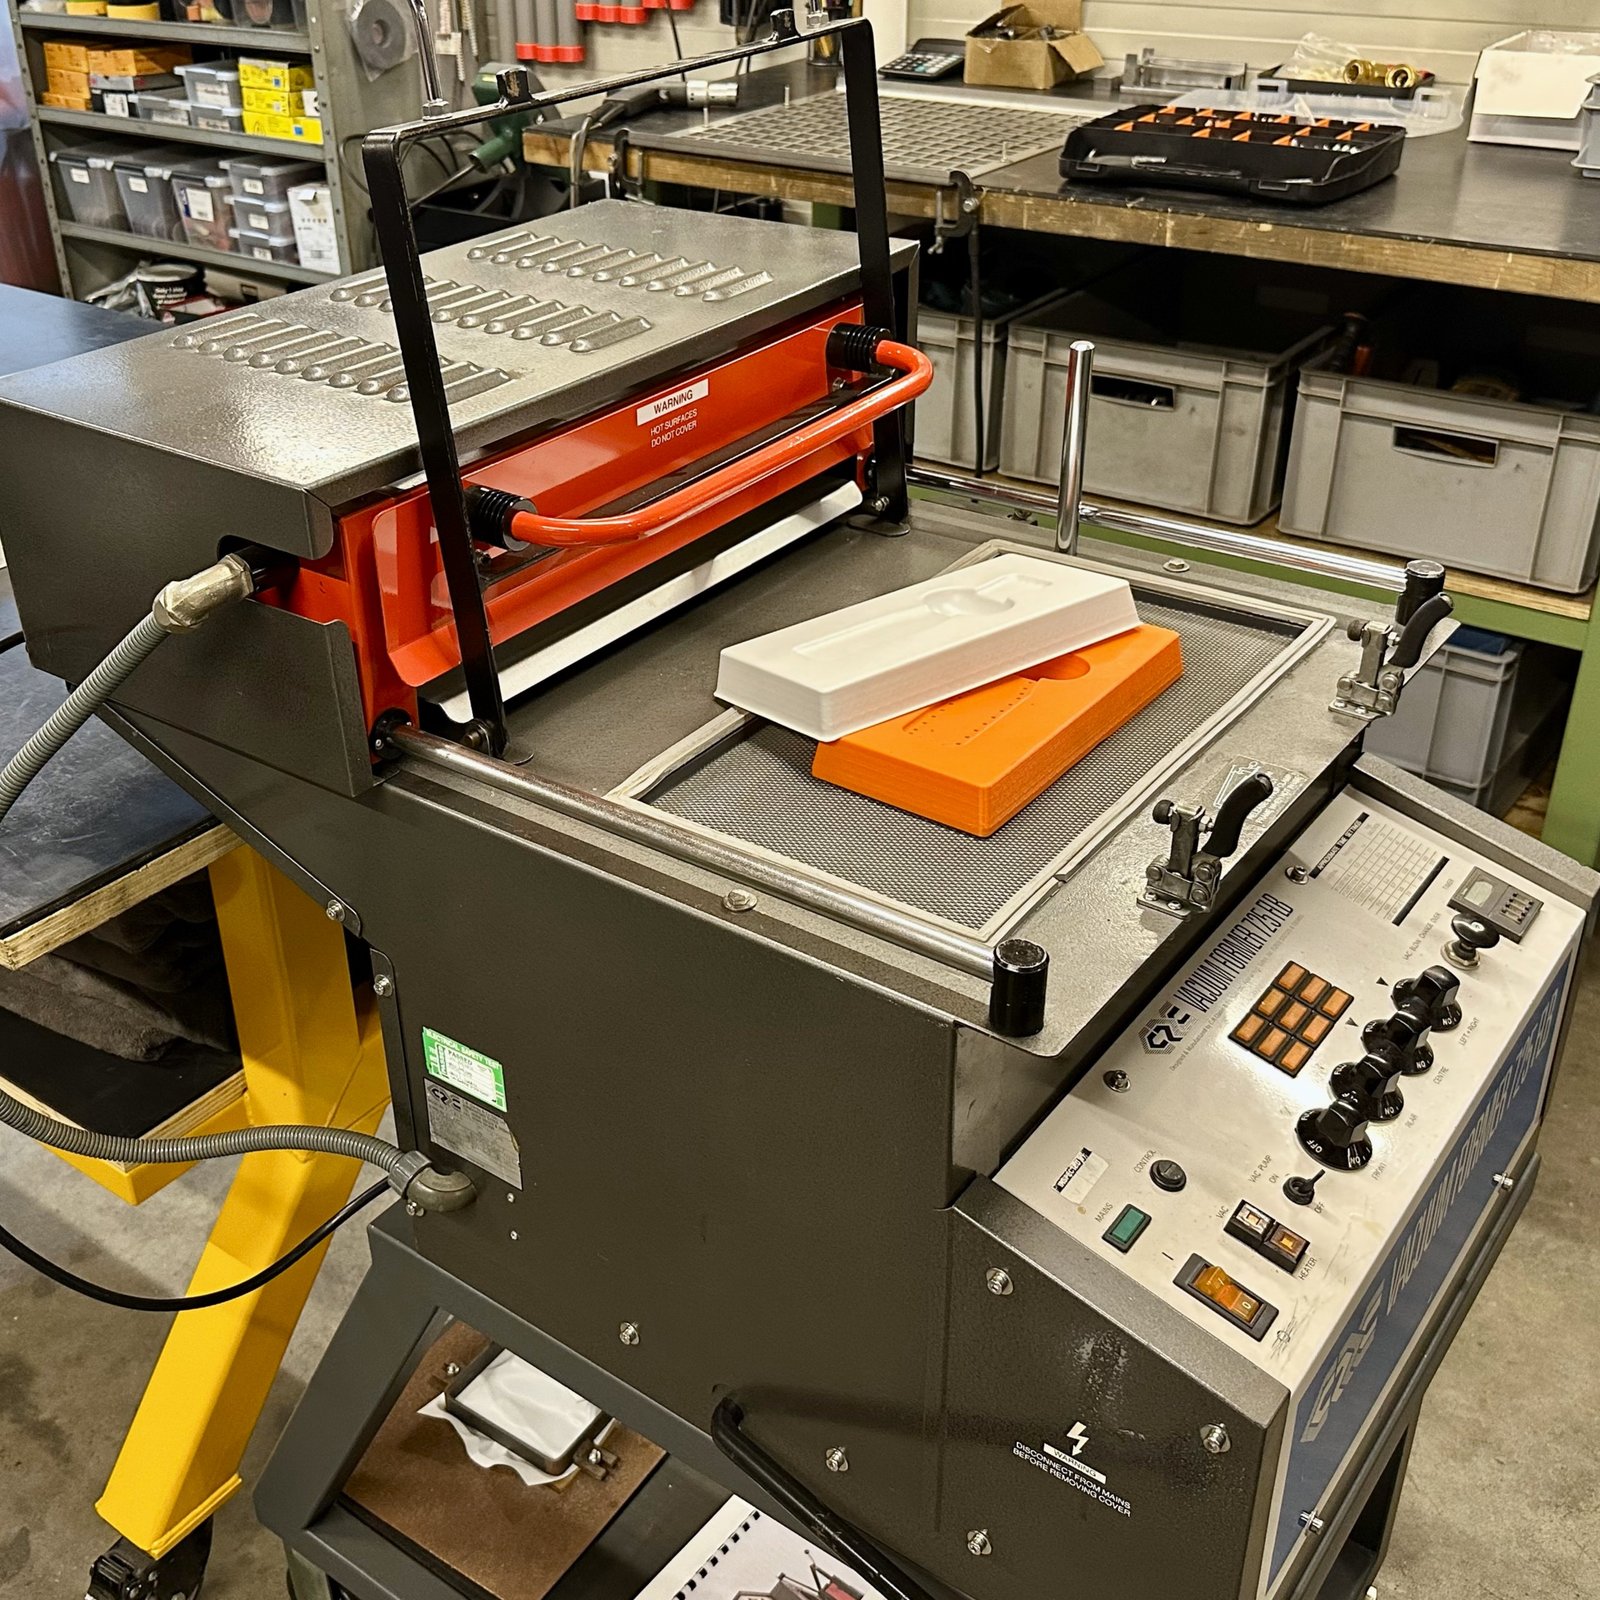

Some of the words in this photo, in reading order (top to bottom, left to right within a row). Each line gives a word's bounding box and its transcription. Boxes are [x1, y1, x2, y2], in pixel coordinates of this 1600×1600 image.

[653, 389, 693, 414] WARNING
[650, 423, 665, 436] HOT
[665, 408, 698, 430] SURFACES
[651, 437, 661, 448] DO
[661, 430, 675, 442] NOT
[675, 420, 697, 437] COVER
[1256, 893, 1294, 921] FLB
[1241, 907, 1282, 938] 725
[1209, 924, 1267, 974] FORMER
[1173, 959, 1236, 1013] VACUUM
[1458, 1031, 1469, 1046] LEFT
[1469, 1017, 1480, 1032] RIGHT
[1433, 1066, 1449, 1085] CENTRE
[1306, 1139, 1323, 1154] OFF
[1387, 1157, 1459, 1316] VACUUM
[1458, 1065, 1513, 1193] FORMER
[1507, 1023, 1538, 1110] 725
[1530, 988, 1559, 1068] FLB
[1134, 1149, 1157, 1174] CONTROL
[1248, 1170, 1262, 1183] VAC
[1258, 1155, 1272, 1172] PUMP
[1269, 1173, 1280, 1184] ON
[1095, 1202, 1113, 1223] MAINS
[1216, 1206, 1229, 1219] VAC
[1298, 1256, 1318, 1280] HEATER
[1016, 1441, 1073, 1477] DISCONNECT
[1074, 1473, 1101, 1493] FROM
[1101, 1488, 1131, 1509] MAINS
[1053, 1449, 1097, 1478] WARNING
[1012, 1447, 1049, 1473] BEFORE
[1049, 1468, 1098, 1499] REMOVING
[1098, 1495, 1131, 1517] COVER
